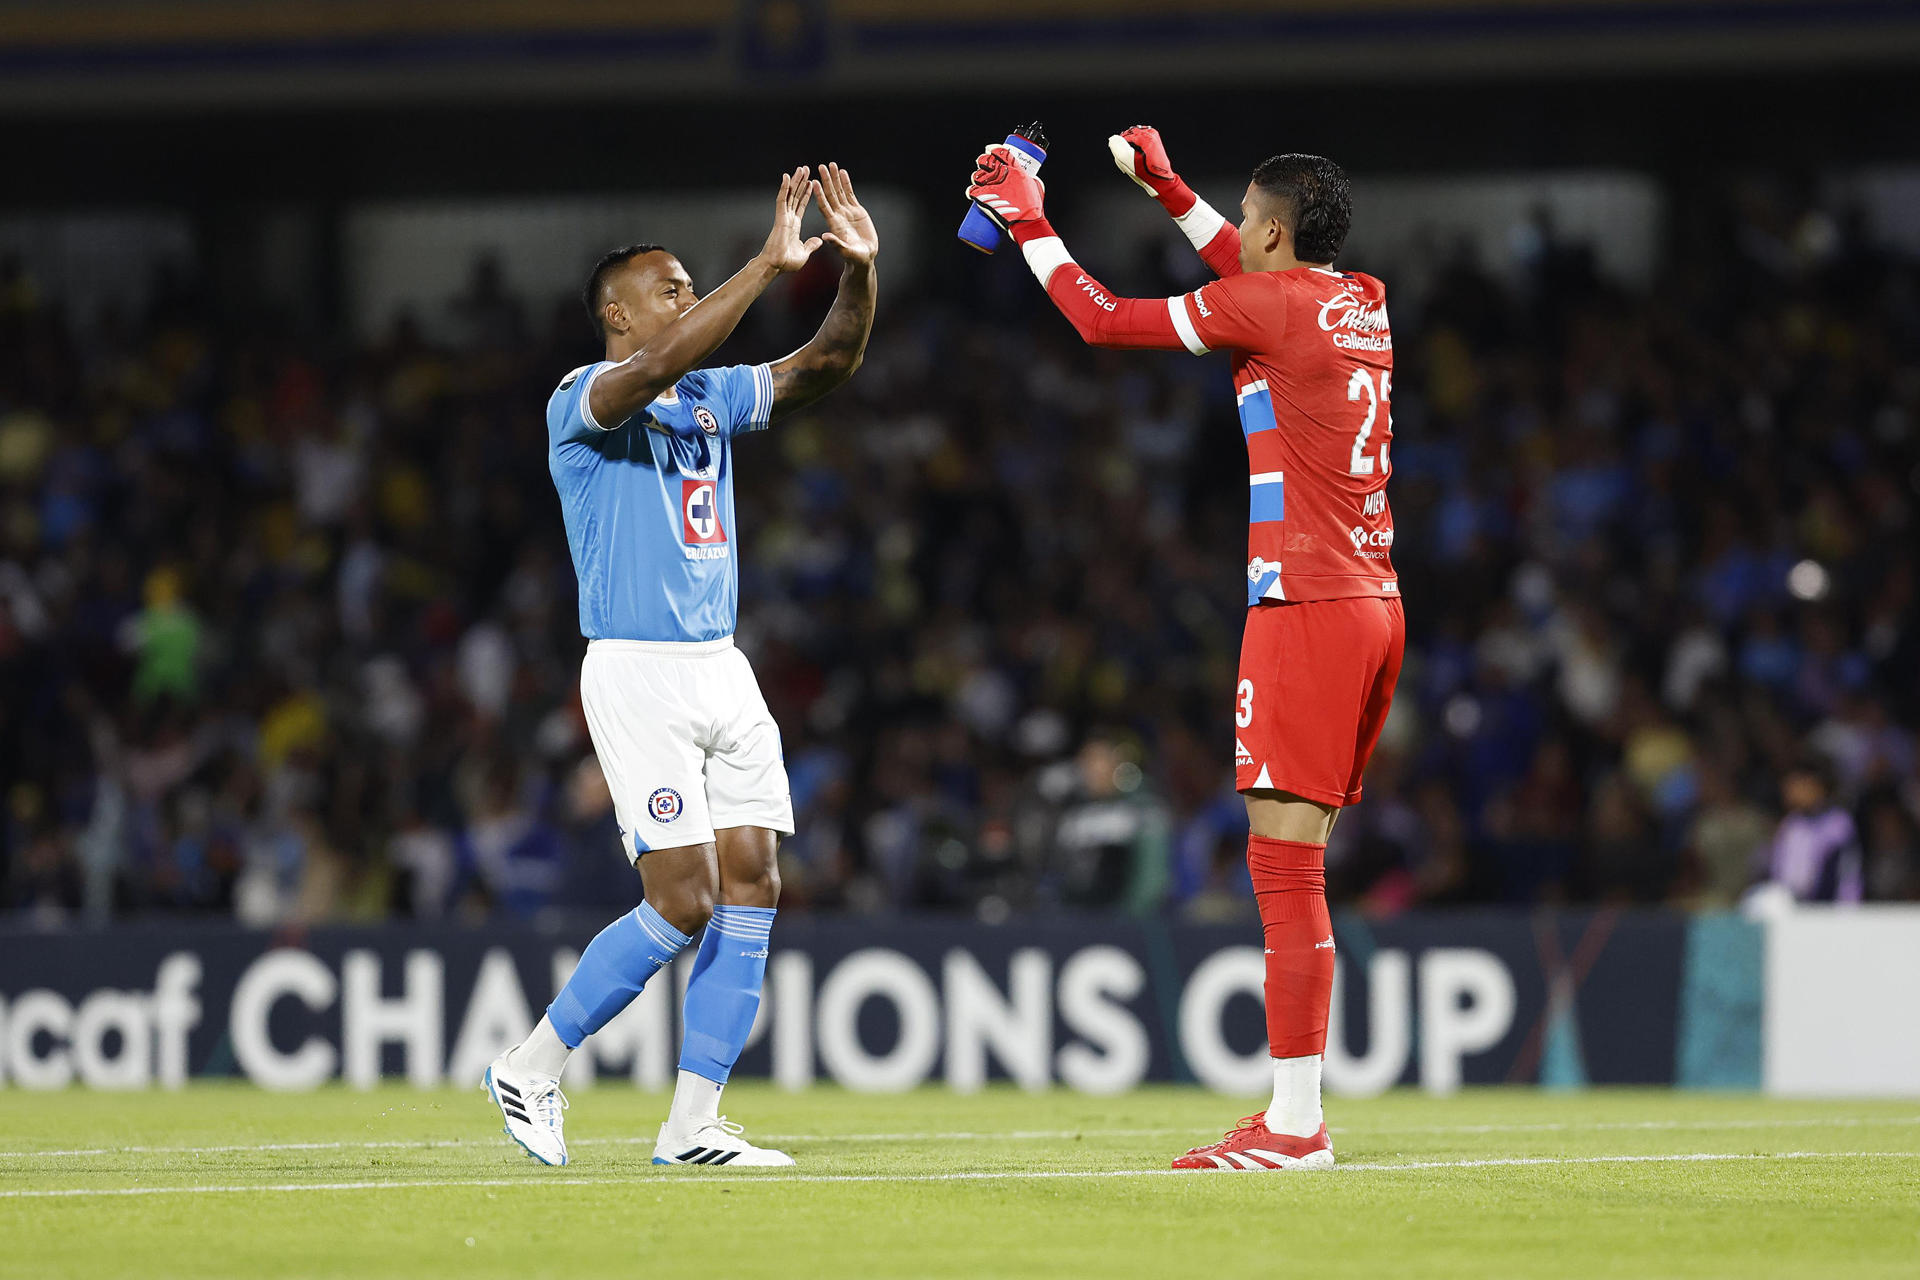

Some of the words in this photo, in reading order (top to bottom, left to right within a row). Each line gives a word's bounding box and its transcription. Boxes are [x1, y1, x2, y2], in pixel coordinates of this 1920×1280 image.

[1362, 489, 1386, 516] MIER
[0, 950, 203, 1092] caf
[230, 946, 1151, 1096] CHAMIONS
[1178, 945, 1517, 1097] CUP
